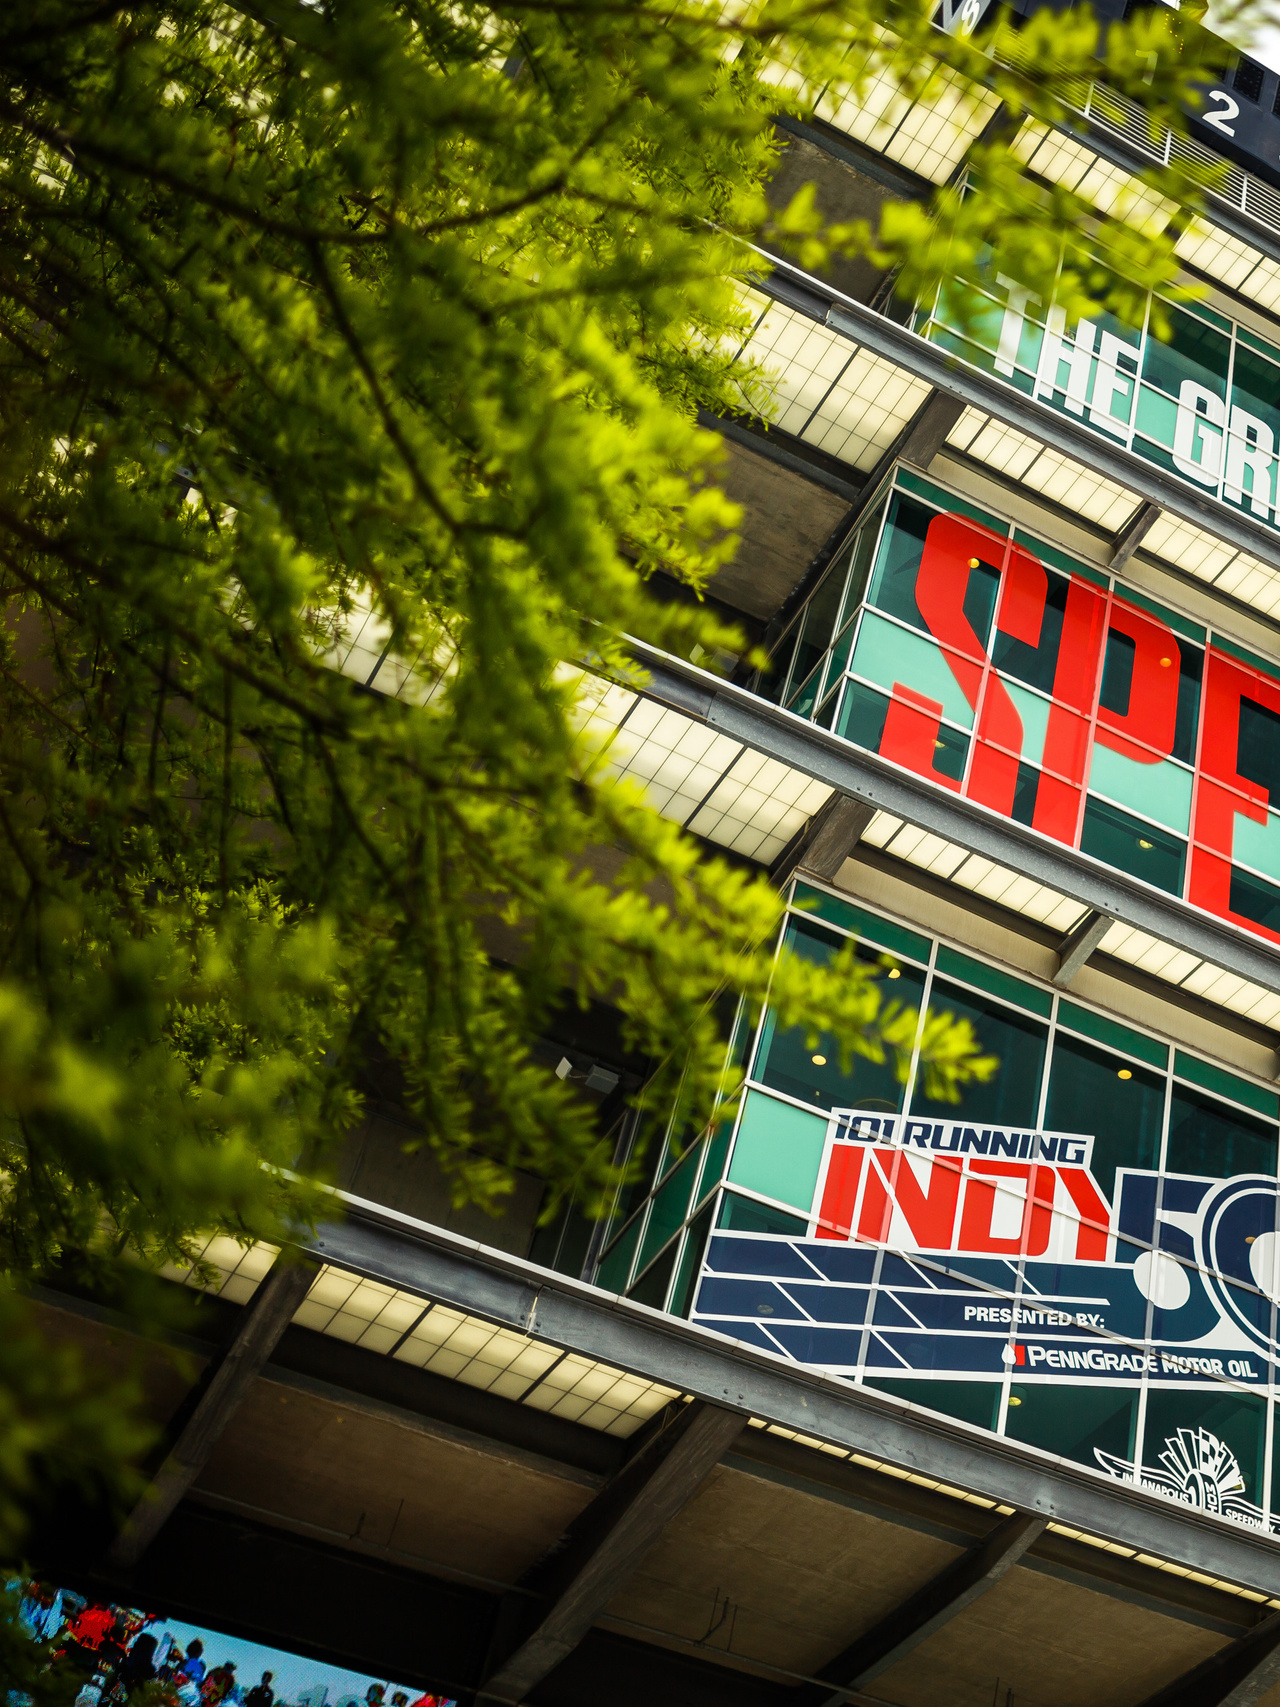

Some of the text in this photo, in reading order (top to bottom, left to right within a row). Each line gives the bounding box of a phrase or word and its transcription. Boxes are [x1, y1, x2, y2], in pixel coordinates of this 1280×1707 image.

[1202, 90, 1240, 137] 2
[992, 272, 1139, 440] THE
[835, 1114, 1088, 1165] 101 RUNNING
[814, 1143, 1111, 1262] INDY
[964, 1305, 1105, 1329] PRESENTED BY:
[1161, 1351, 1226, 1376] MOTOR
[1228, 1359, 1259, 1378] OIL
[1122, 1472, 1189, 1503] INANAPOLIS
[1225, 1508, 1275, 1534] SPEEDWY
